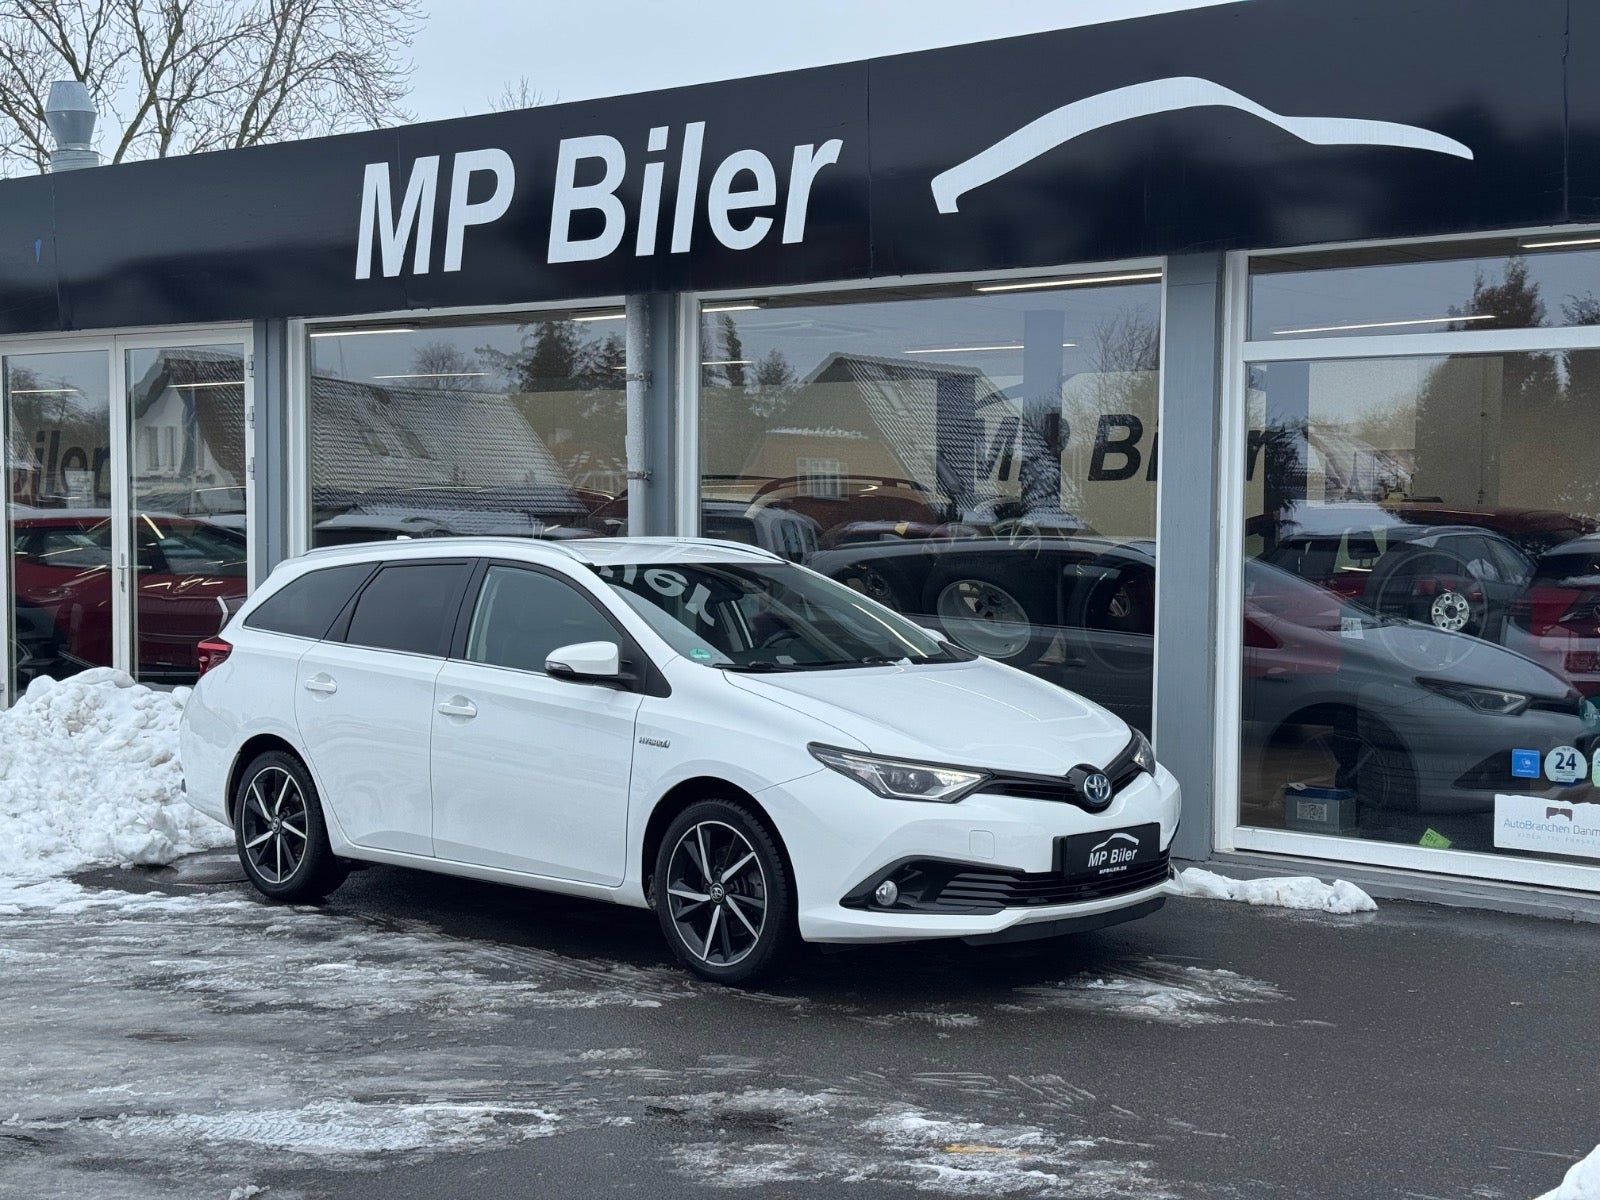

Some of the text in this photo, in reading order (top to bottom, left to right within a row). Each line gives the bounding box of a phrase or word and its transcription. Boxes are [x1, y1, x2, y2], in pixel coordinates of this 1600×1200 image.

[355, 121, 843, 279] MP Biler
[1555, 752, 1577, 770] 24
[1503, 818, 1570, 834] AutoBranchen
[1087, 848, 1137, 867] MP Biler
